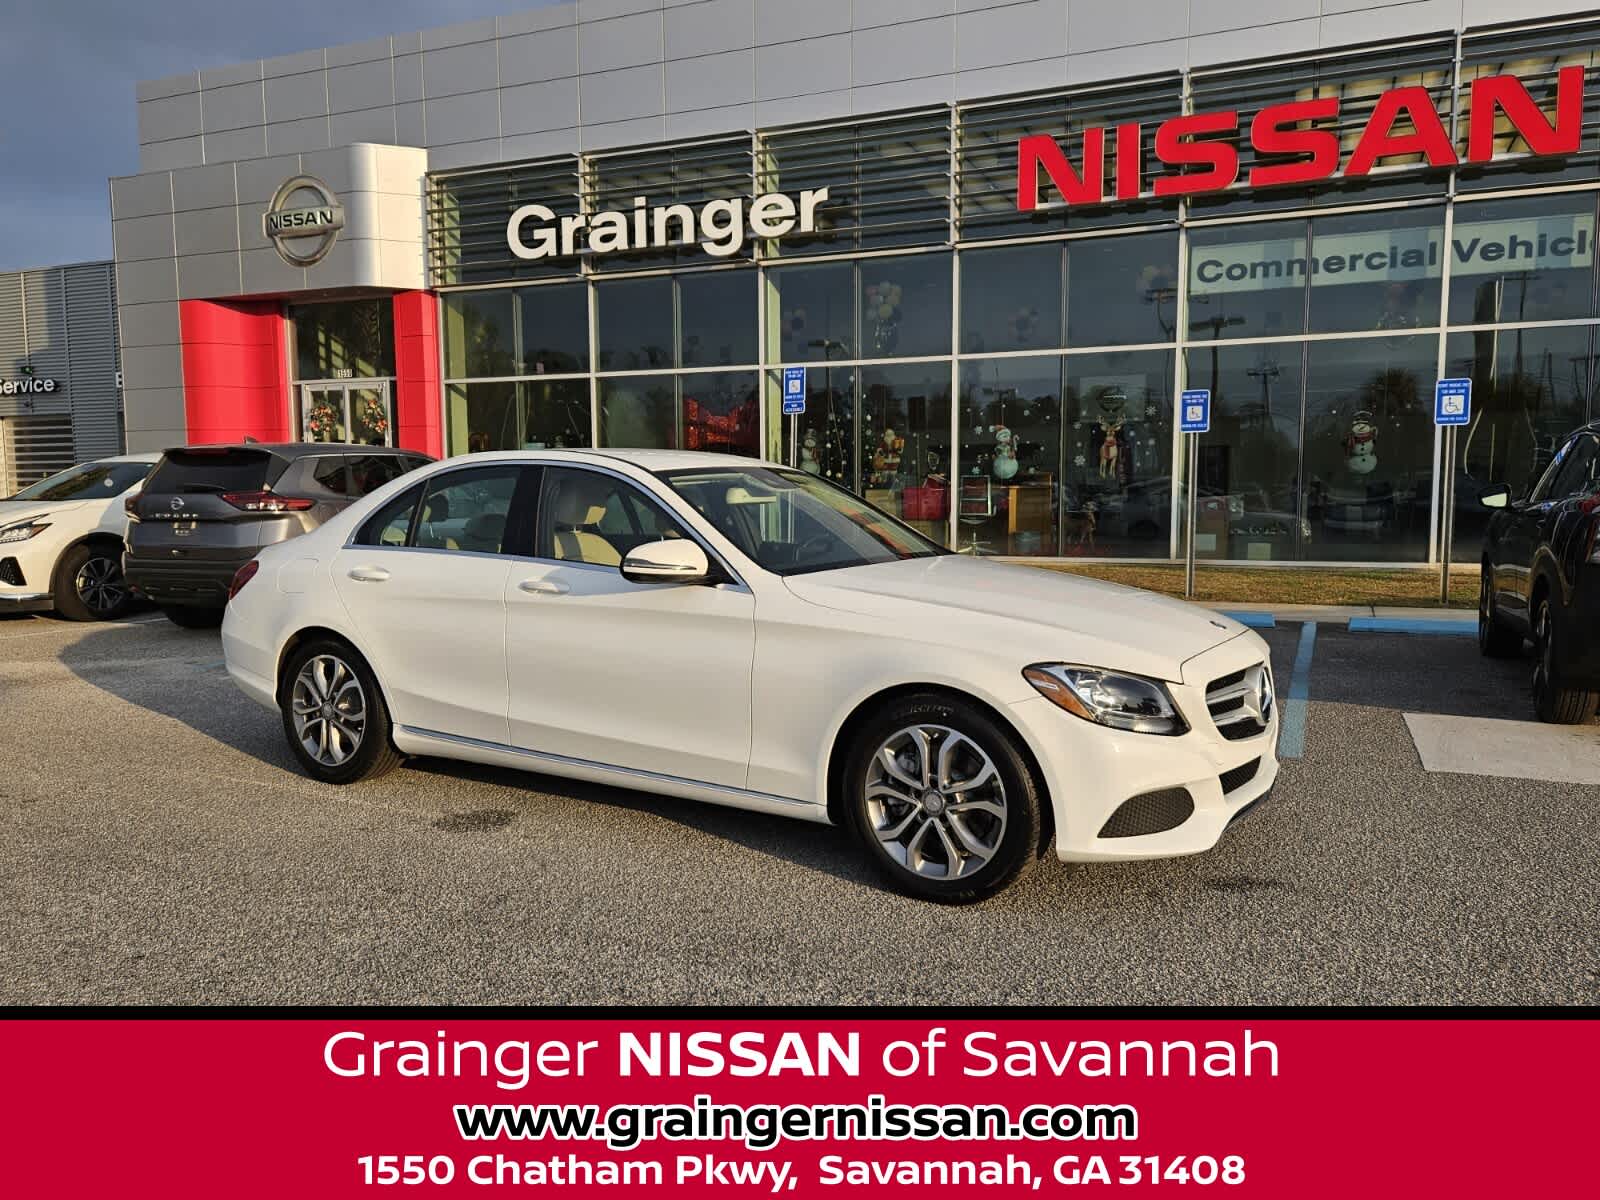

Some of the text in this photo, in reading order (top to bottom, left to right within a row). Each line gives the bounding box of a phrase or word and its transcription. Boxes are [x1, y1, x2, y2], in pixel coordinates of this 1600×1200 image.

[1017, 66, 1585, 211] NISSAN
[269, 209, 334, 229] NISSAN
[506, 186, 829, 260] Grainger
[1197, 229, 1592, 283] Commercial Vehicl
[0, 377, 55, 394] ervice
